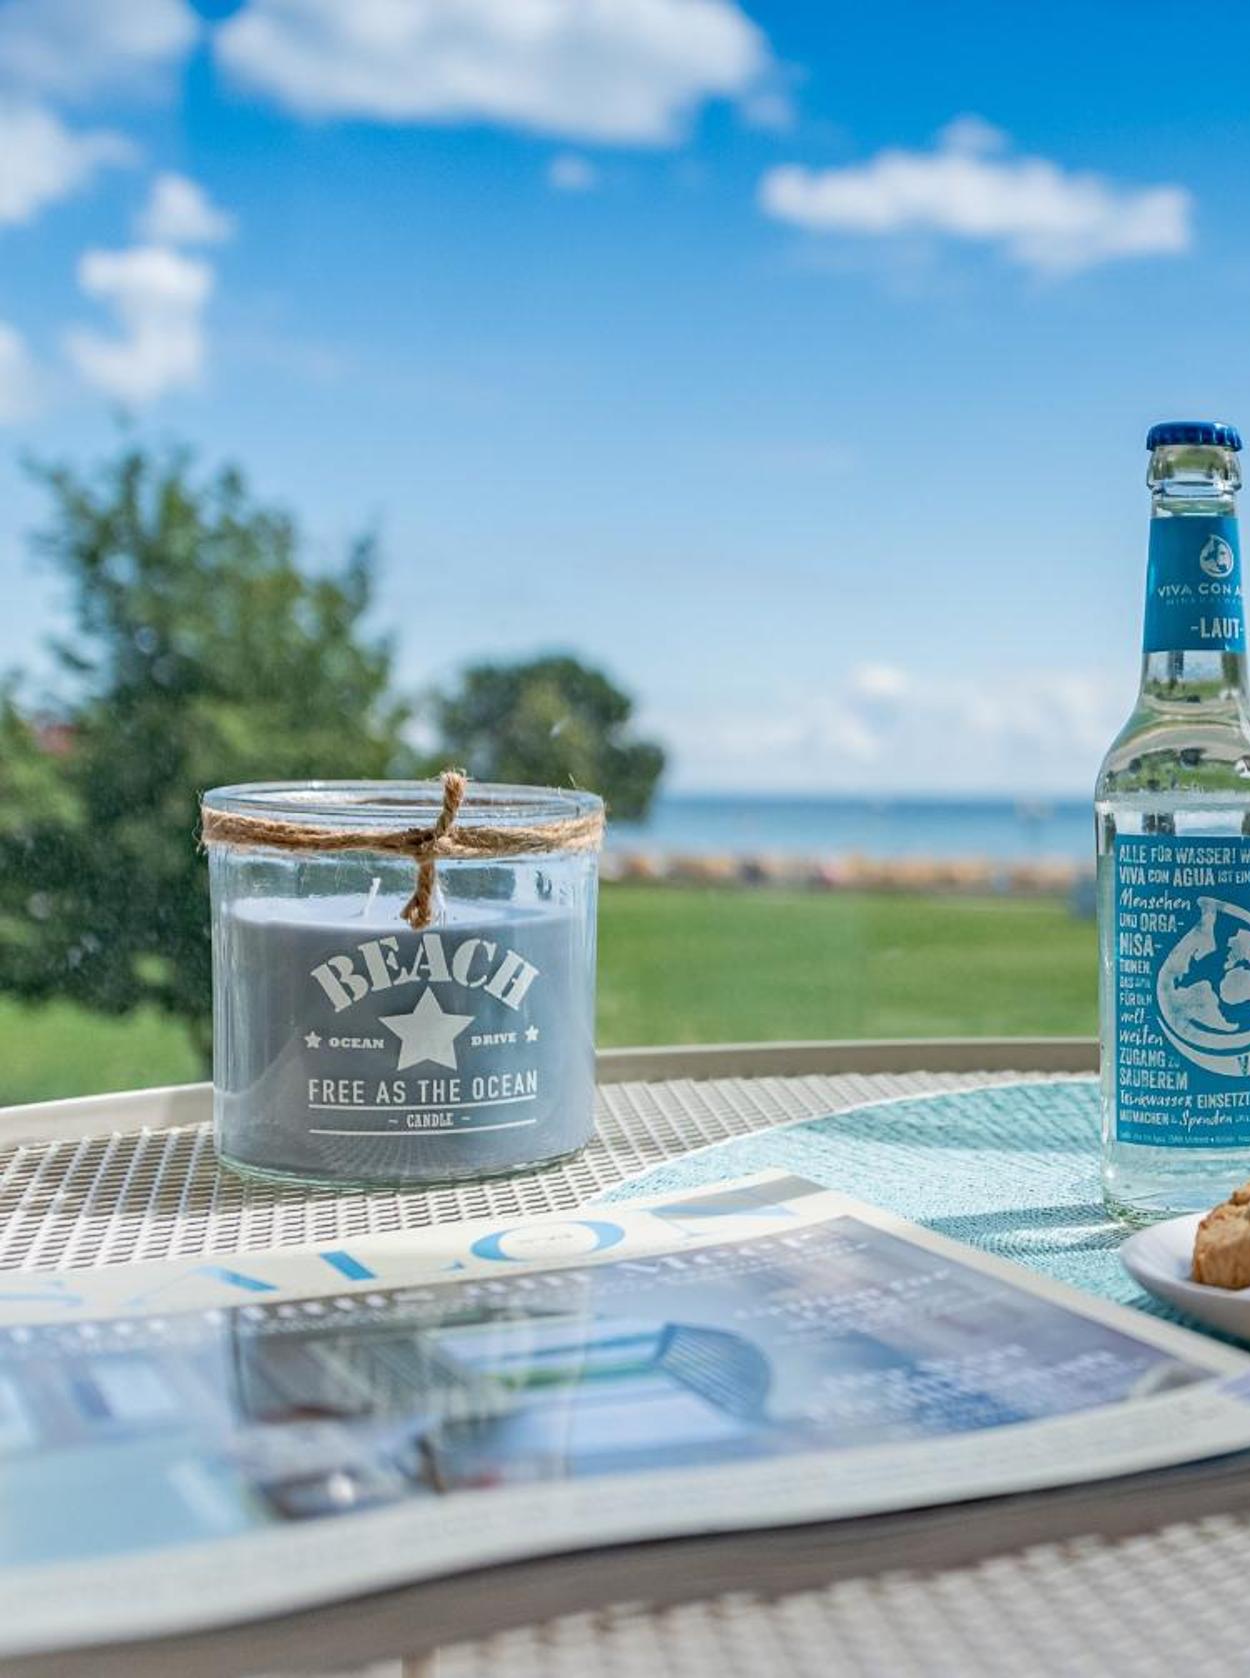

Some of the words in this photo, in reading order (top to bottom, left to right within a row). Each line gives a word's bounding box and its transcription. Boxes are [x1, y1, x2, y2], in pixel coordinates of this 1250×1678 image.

[1157, 584, 1192, 598] VIVA
[1198, 583, 1231, 595] CON
[1119, 844, 1148, 864] ALLE
[1151, 845, 1173, 863] FÜR
[1175, 847, 1237, 865] WASSER!
[1119, 866, 1146, 885] VIVA
[1147, 868, 1170, 883] CON
[1173, 867, 1216, 887] AGUA
[1236, 870, 1250, 884] EIN
[1119, 888, 1192, 911] Menschen
[1119, 914, 1138, 928] UND
[1139, 912, 1185, 933] ORGA-
[1119, 932, 1162, 957] NISA-
[308, 932, 542, 1013] BEACH
[328, 1038, 385, 1050] OCEAN
[470, 1031, 518, 1047] DRIVE
[1119, 1025, 1163, 1046] weiten
[1119, 1047, 1166, 1068] ZUGANG
[308, 1079, 366, 1104] FREE
[376, 1080, 407, 1104] AS
[417, 1079, 462, 1103] THE
[472, 1070, 538, 1100] OCEAN
[1119, 1068, 1189, 1091] SAUBEREM
[406, 1112, 455, 1128] CANDLE
[1179, 1109, 1233, 1133] Spenden
